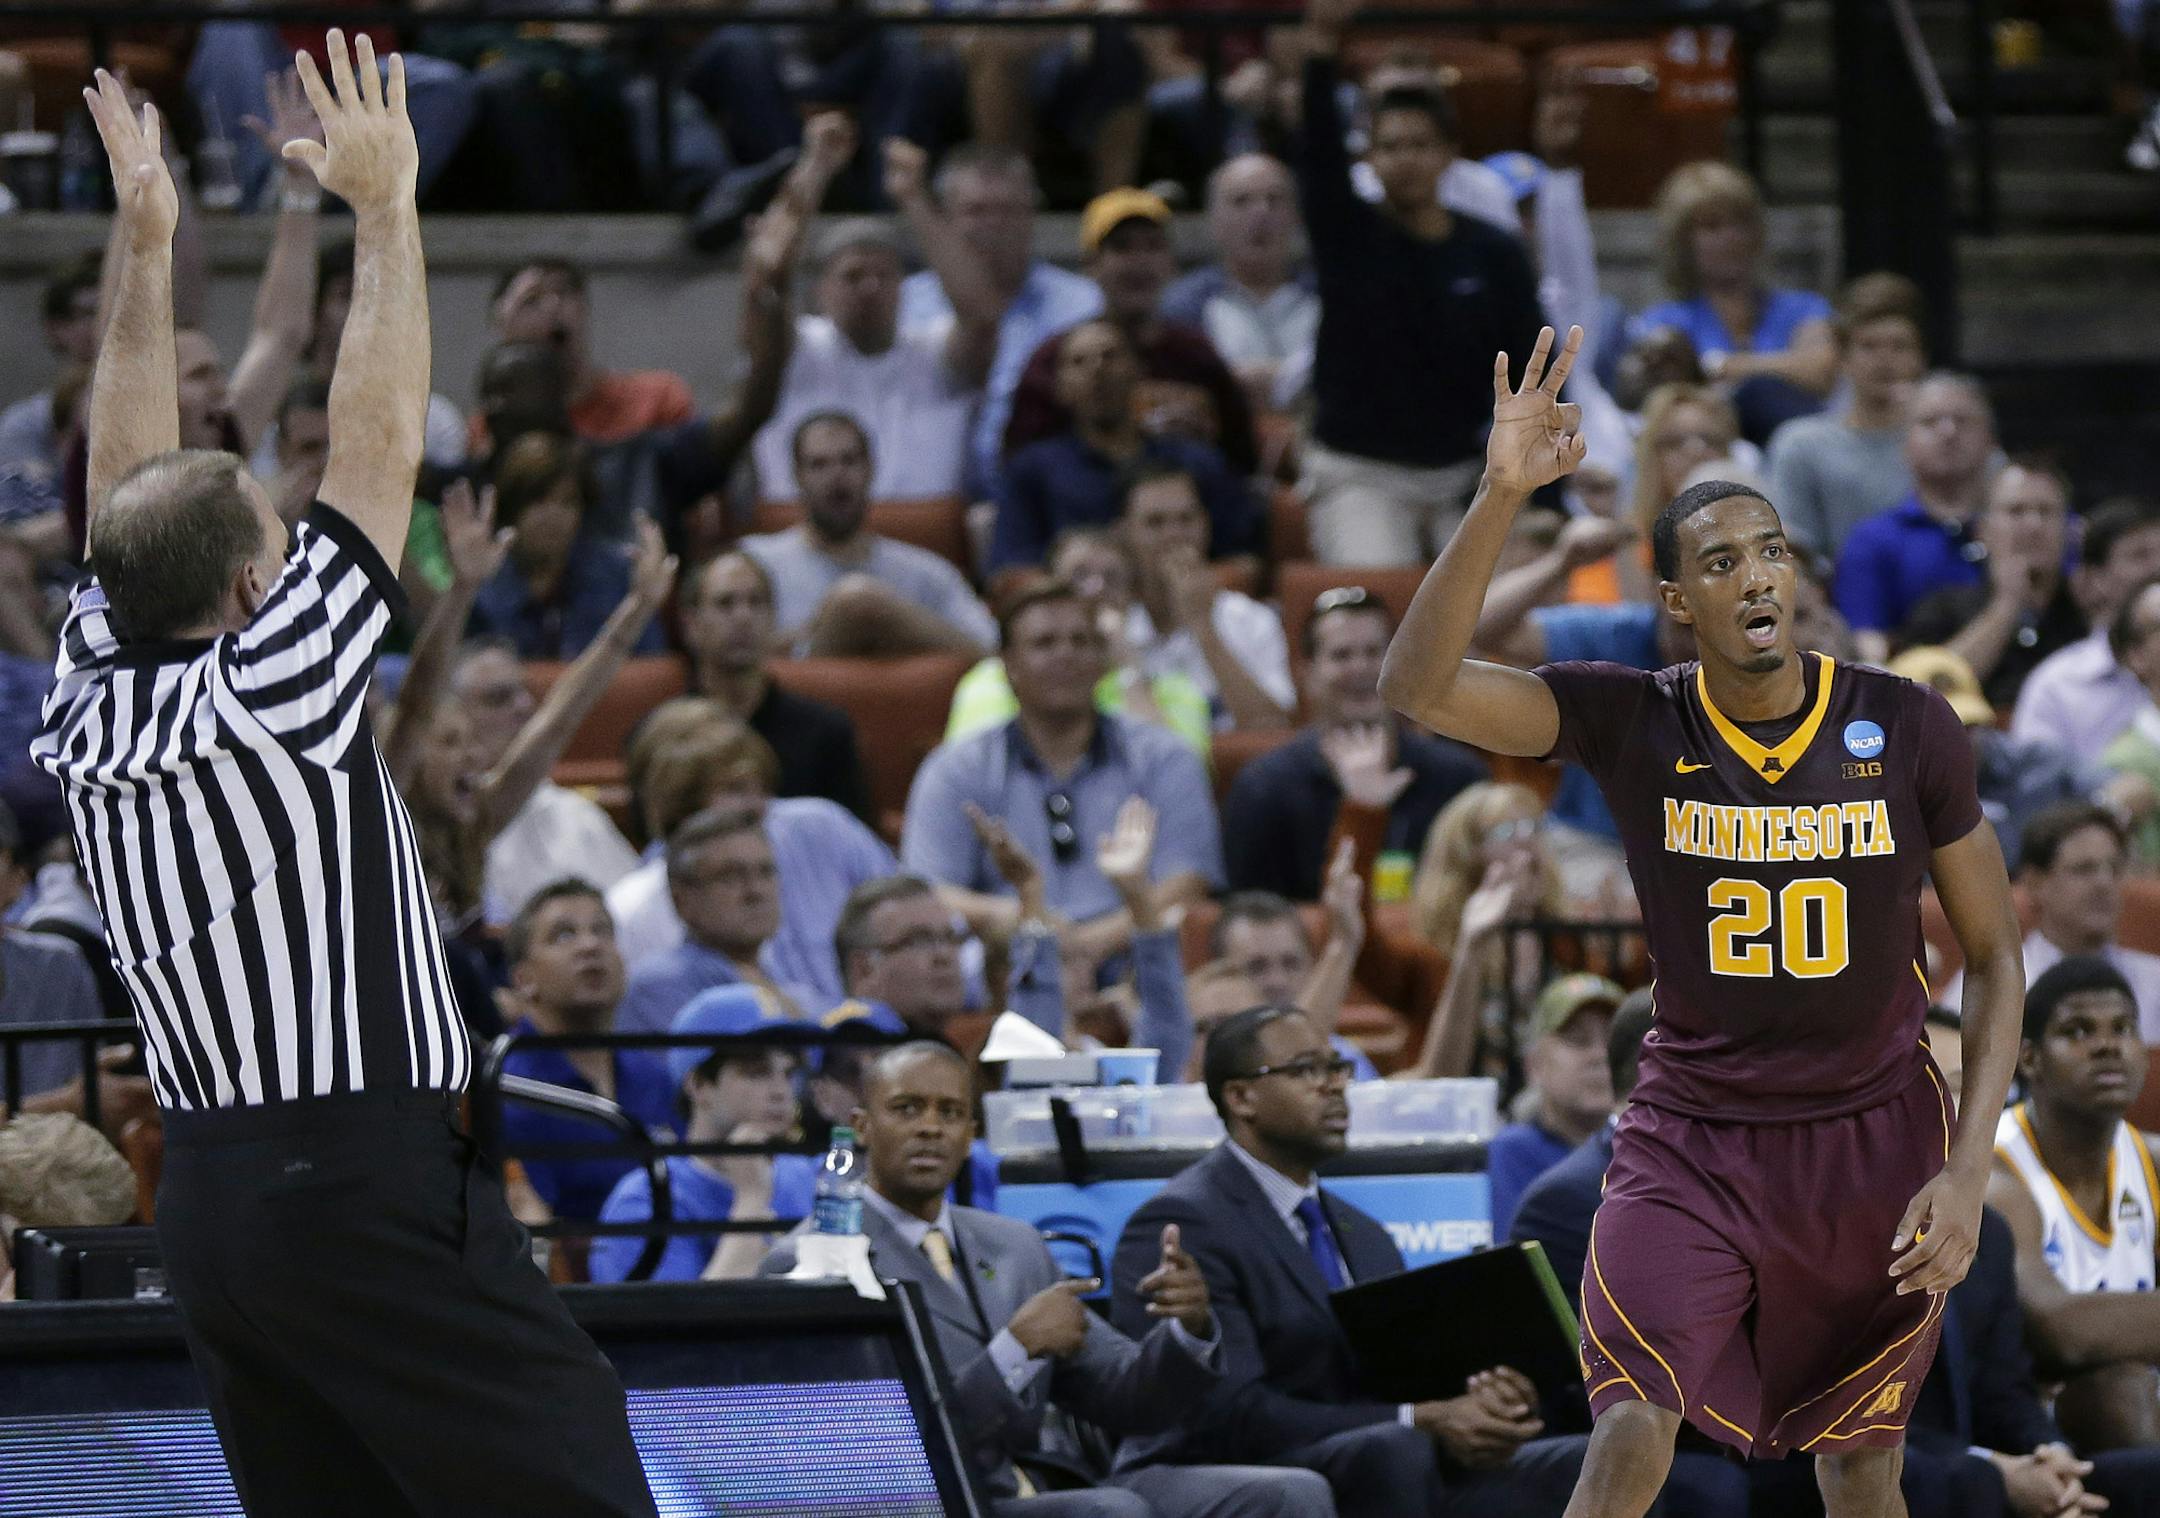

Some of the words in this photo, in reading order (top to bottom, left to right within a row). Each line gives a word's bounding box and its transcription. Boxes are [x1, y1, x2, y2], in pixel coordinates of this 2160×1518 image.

[1850, 735, 1884, 750] NCAA
[1663, 797, 1896, 862] MINNESOTA
[1707, 877, 1850, 979] 20
